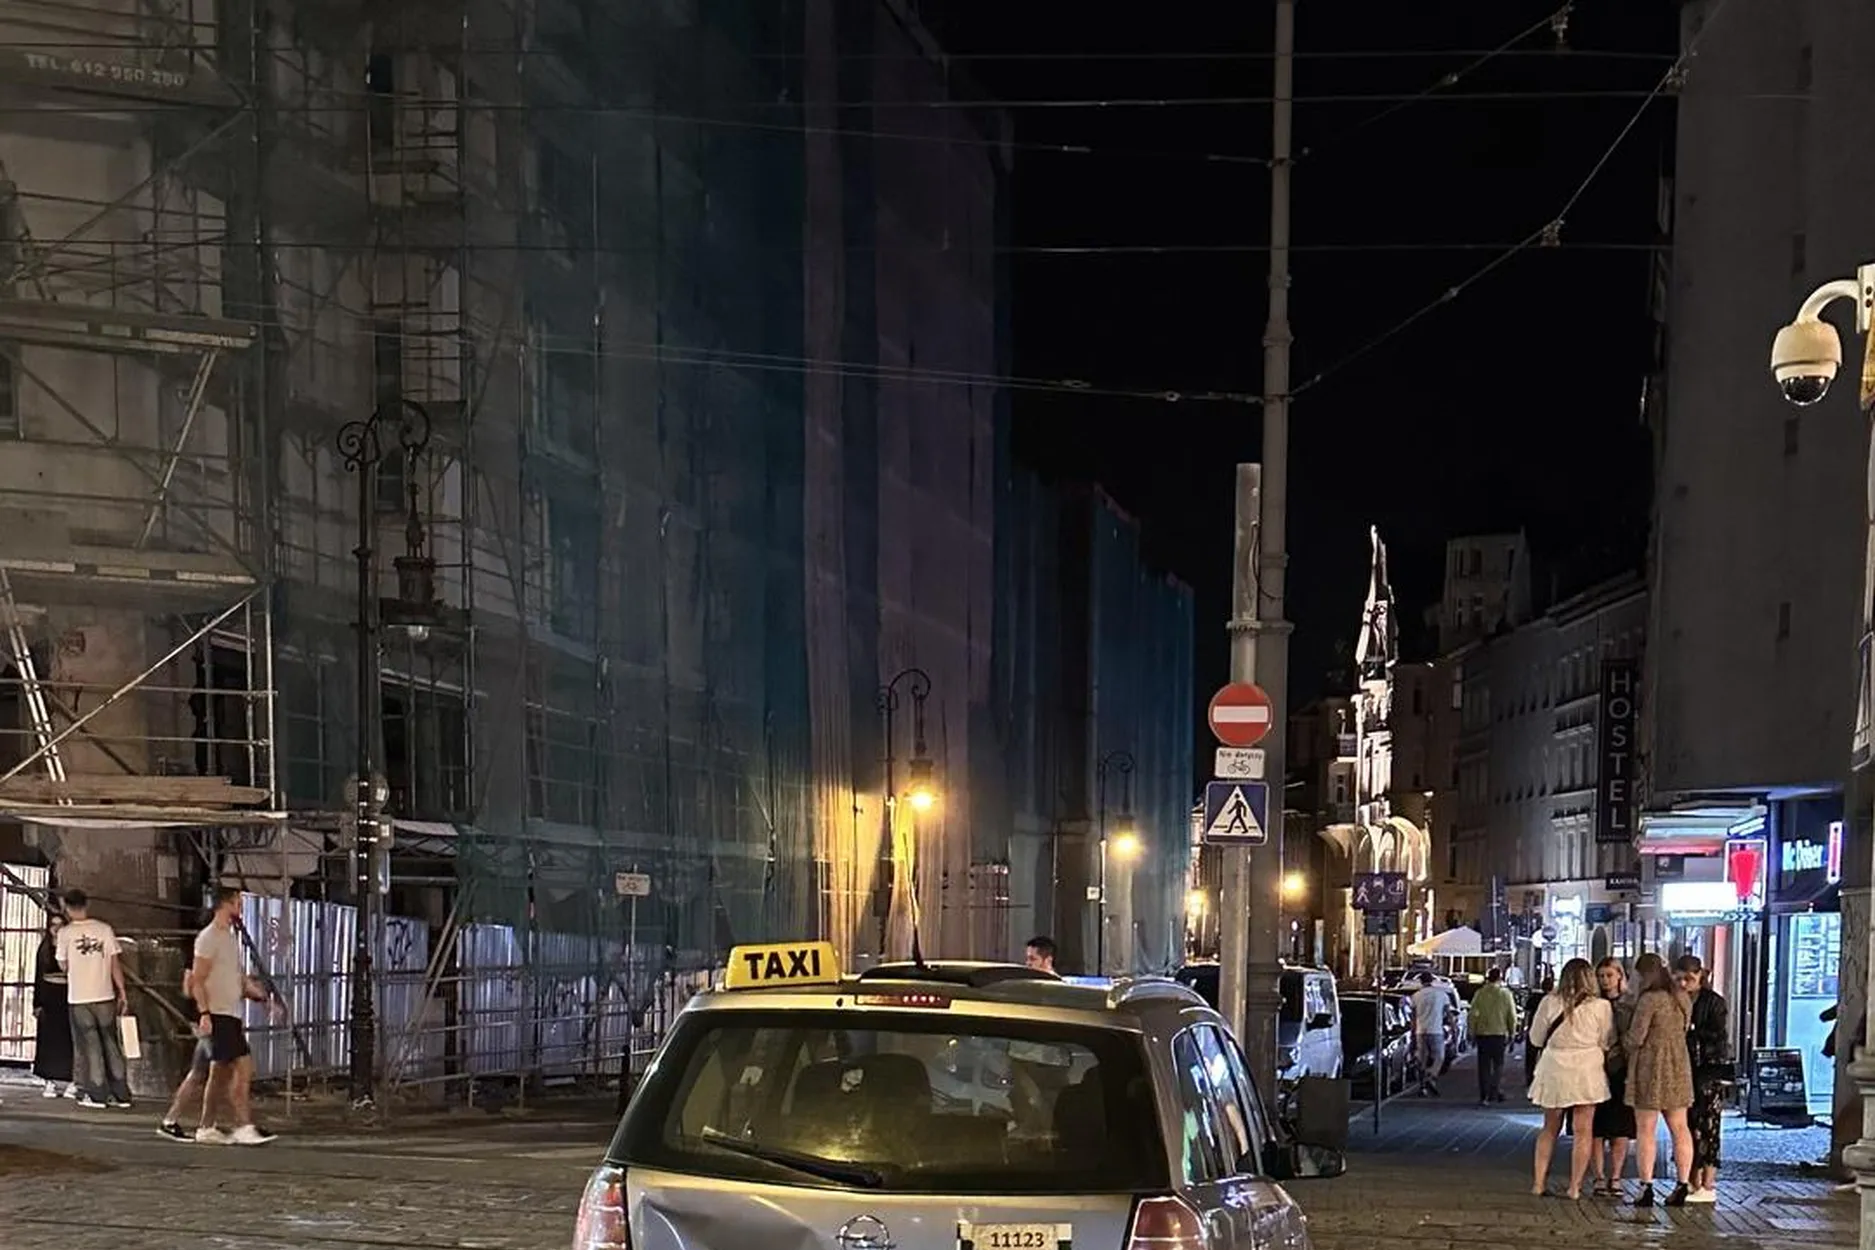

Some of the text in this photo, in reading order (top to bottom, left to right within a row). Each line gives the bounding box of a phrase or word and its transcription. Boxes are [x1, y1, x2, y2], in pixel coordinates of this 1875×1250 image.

[1608, 669, 1630, 828] HOSTEL
[744, 949, 820, 980] TAXI
[990, 1231, 1044, 1248] 11123
